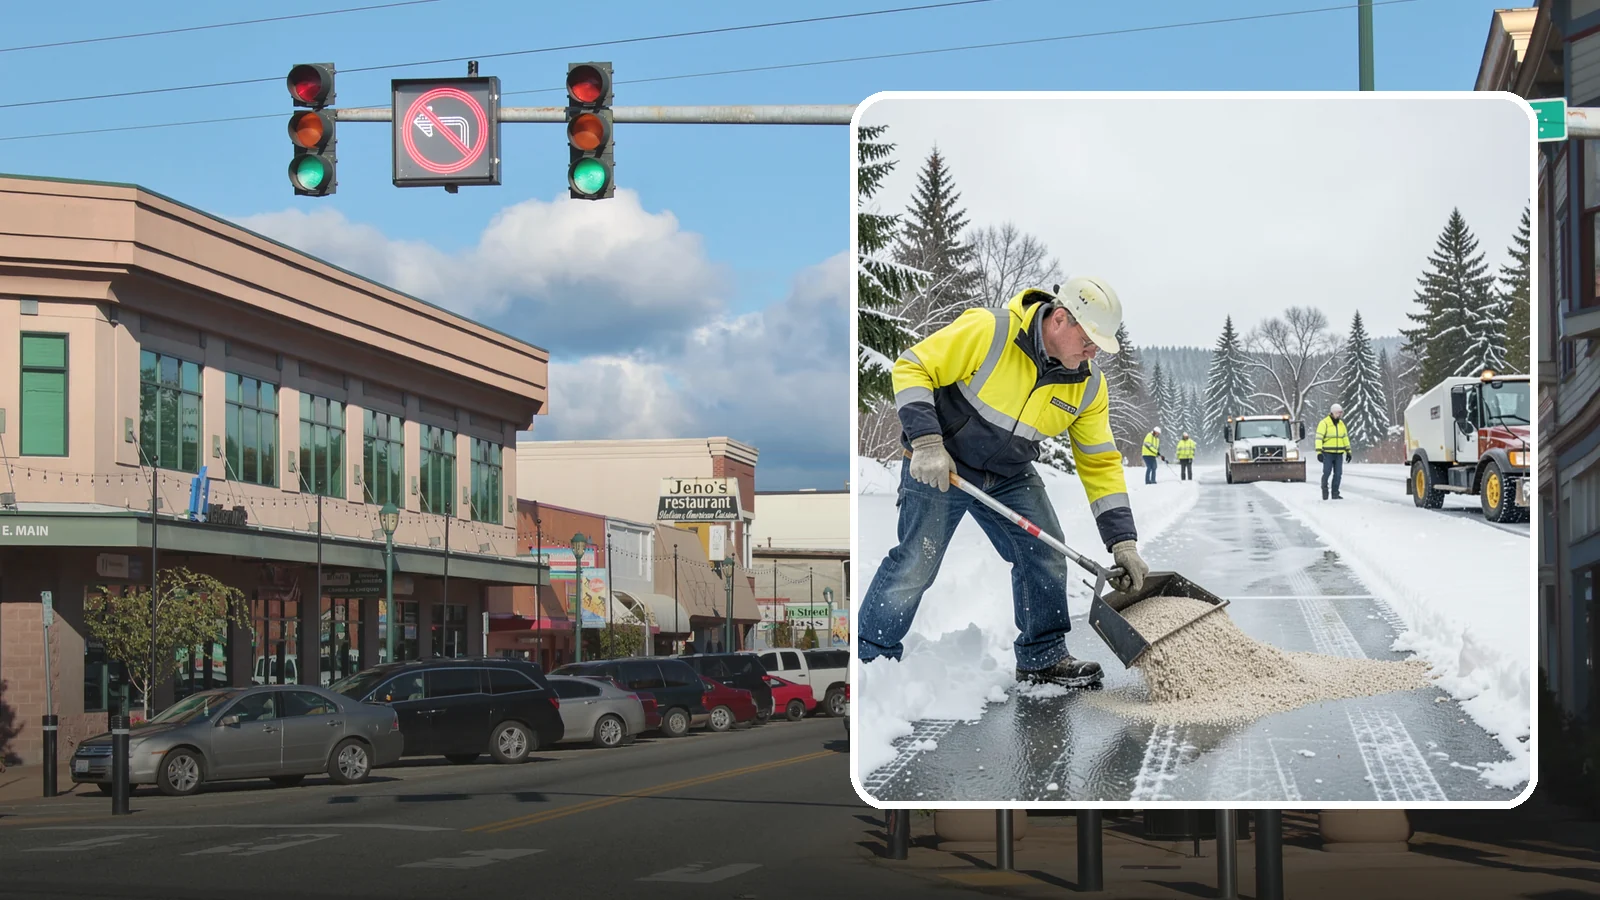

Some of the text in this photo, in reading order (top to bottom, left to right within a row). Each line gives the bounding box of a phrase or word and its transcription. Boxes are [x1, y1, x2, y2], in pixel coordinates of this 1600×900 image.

[670, 480, 728, 495] Jeno's
[665, 496, 731, 509] restaurant
[658, 510, 681, 519] Italian
[686, 510, 715, 519] American
[715, 509, 737, 519] Cuisine
[2, 525, 49, 536] E. MAIN
[797, 608, 828, 616] Street
